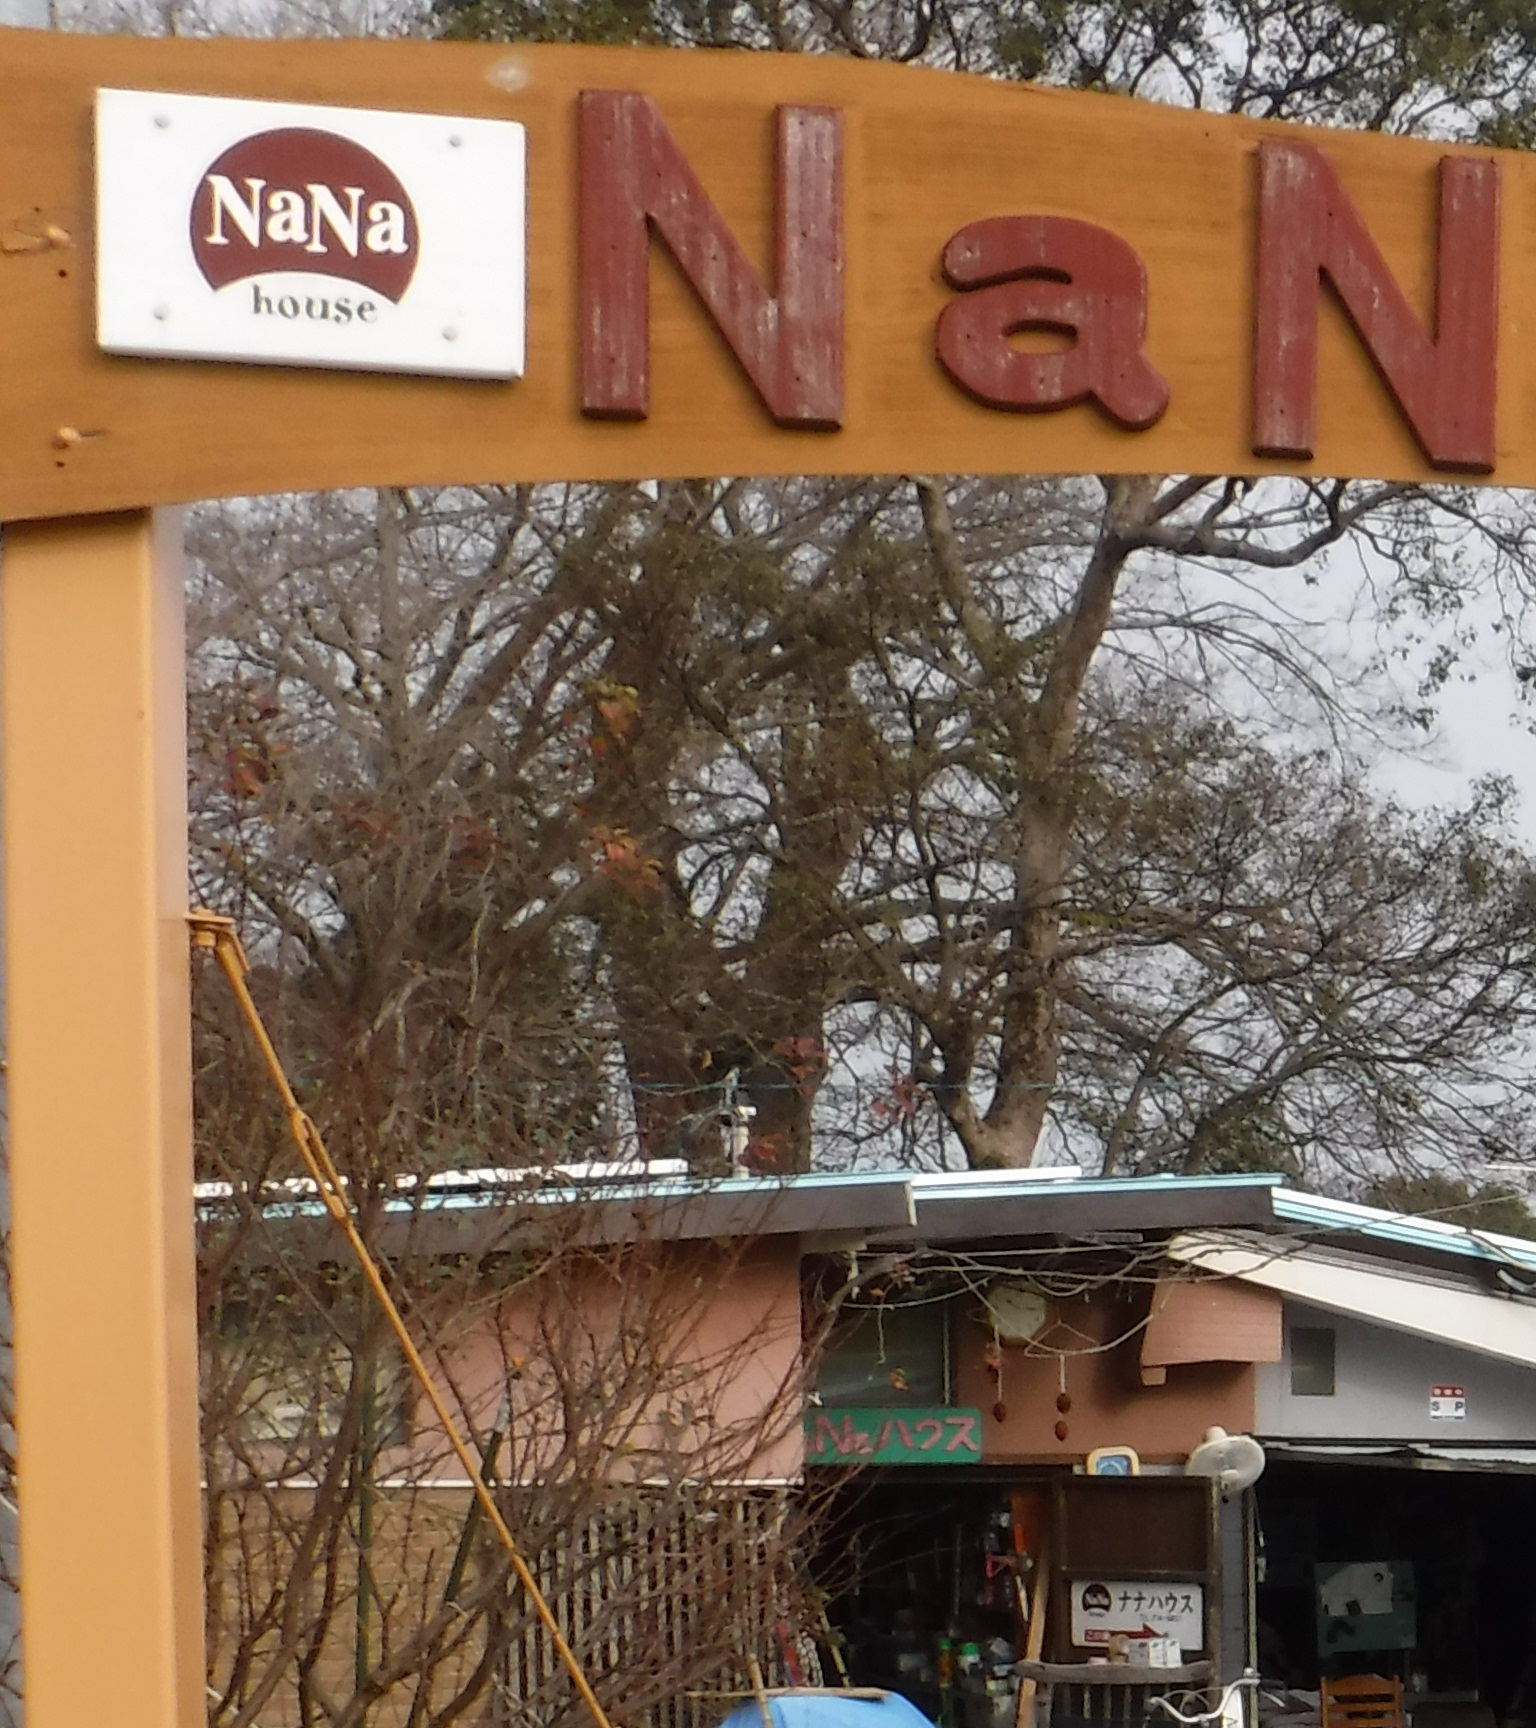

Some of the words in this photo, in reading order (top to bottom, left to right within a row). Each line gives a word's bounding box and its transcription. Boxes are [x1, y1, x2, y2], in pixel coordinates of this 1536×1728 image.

[204, 174, 409, 258] NaNa
[251, 283, 378, 324] house
[1119, 1590, 1193, 1613] ナナハウス
